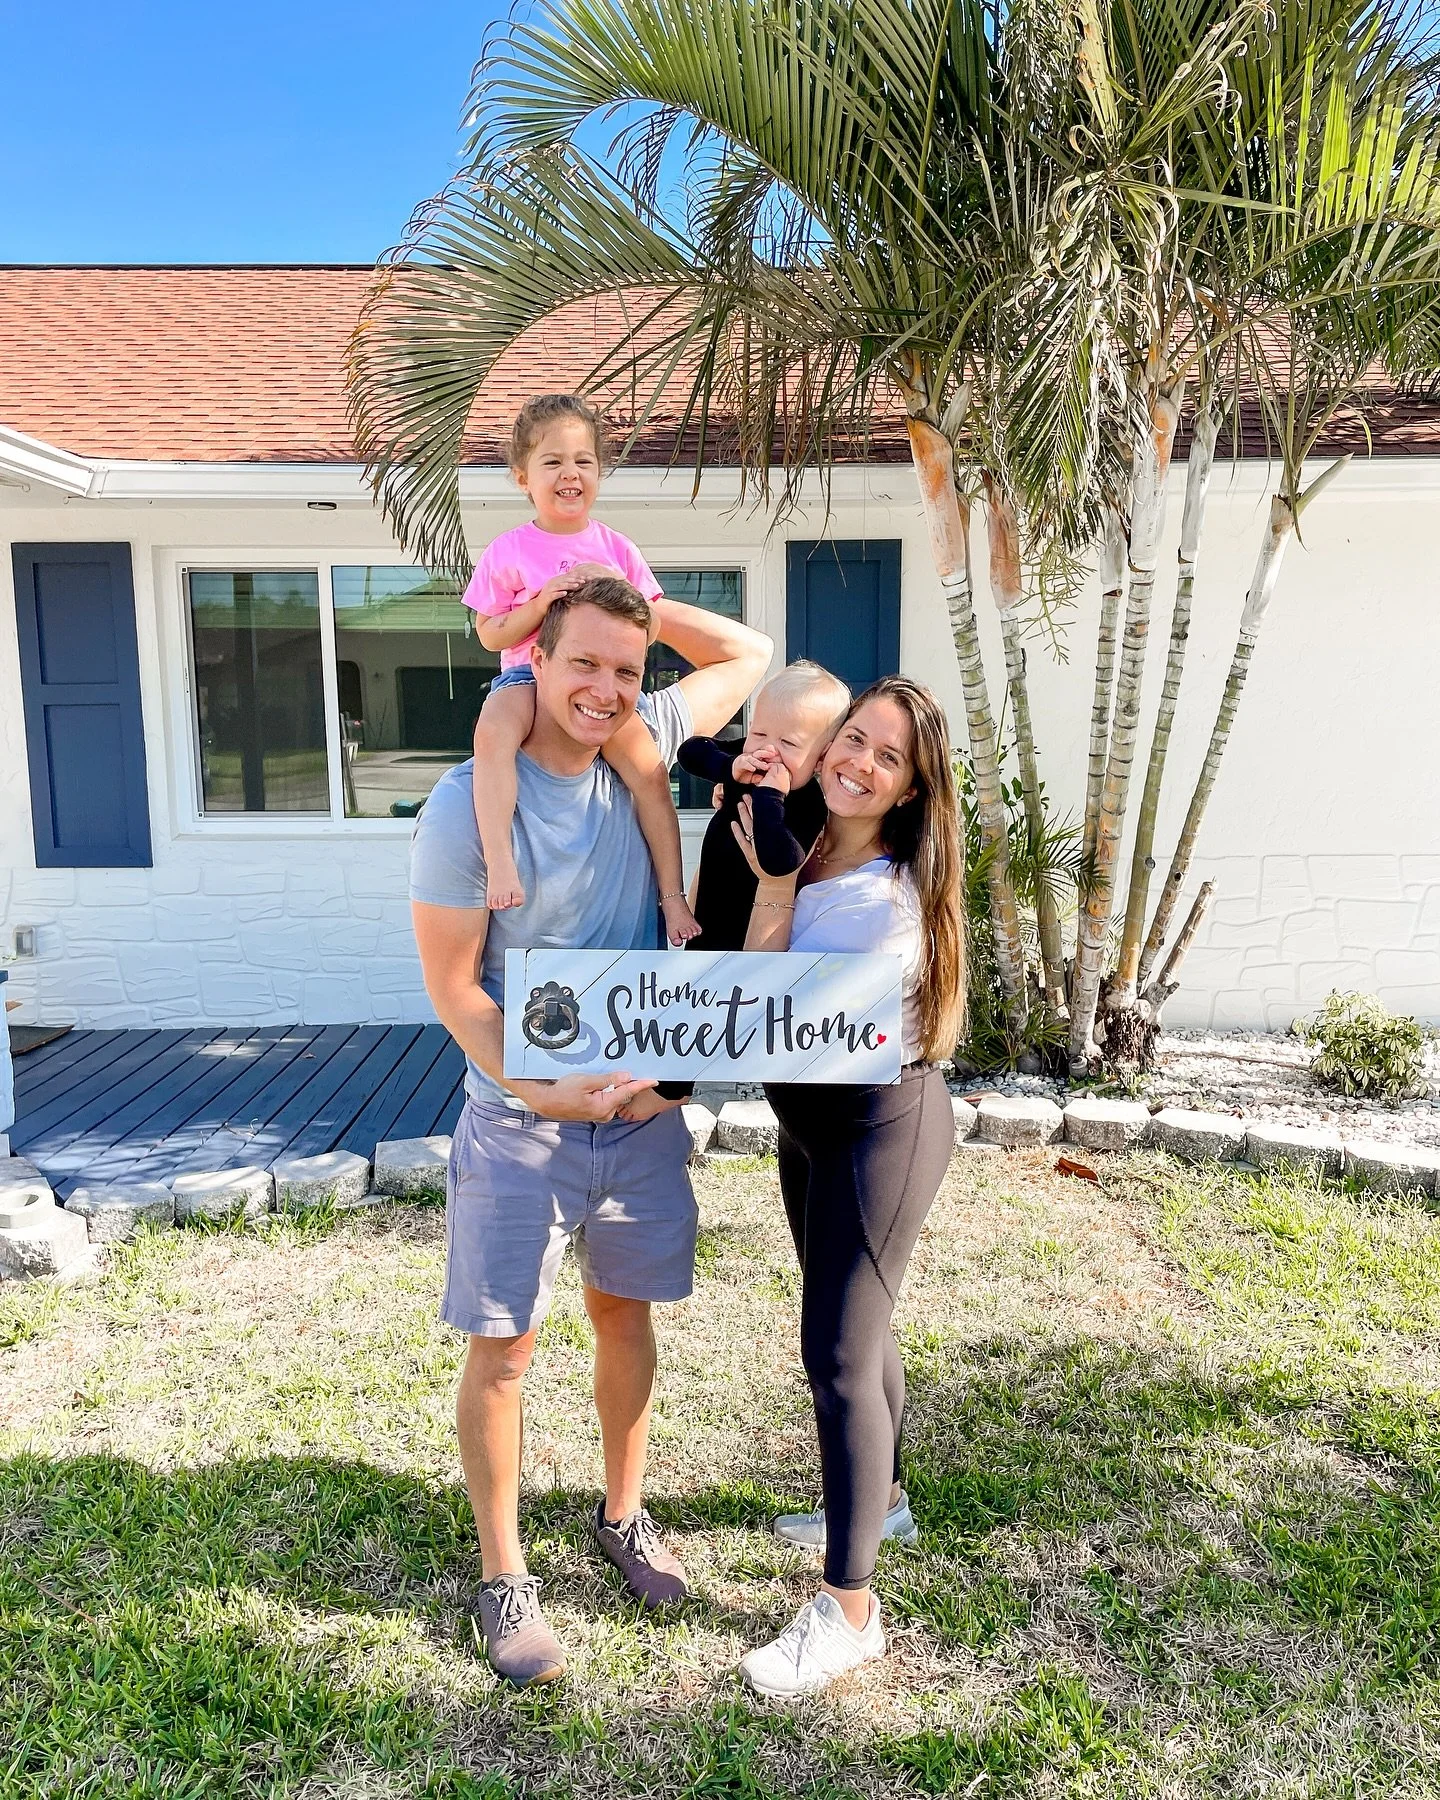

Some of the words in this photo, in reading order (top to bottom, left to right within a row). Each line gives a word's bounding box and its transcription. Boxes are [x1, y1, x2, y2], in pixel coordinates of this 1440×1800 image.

[639, 971, 718, 1011] Home
[604, 984, 760, 1060] Sweet
[766, 994, 880, 1056] Home
